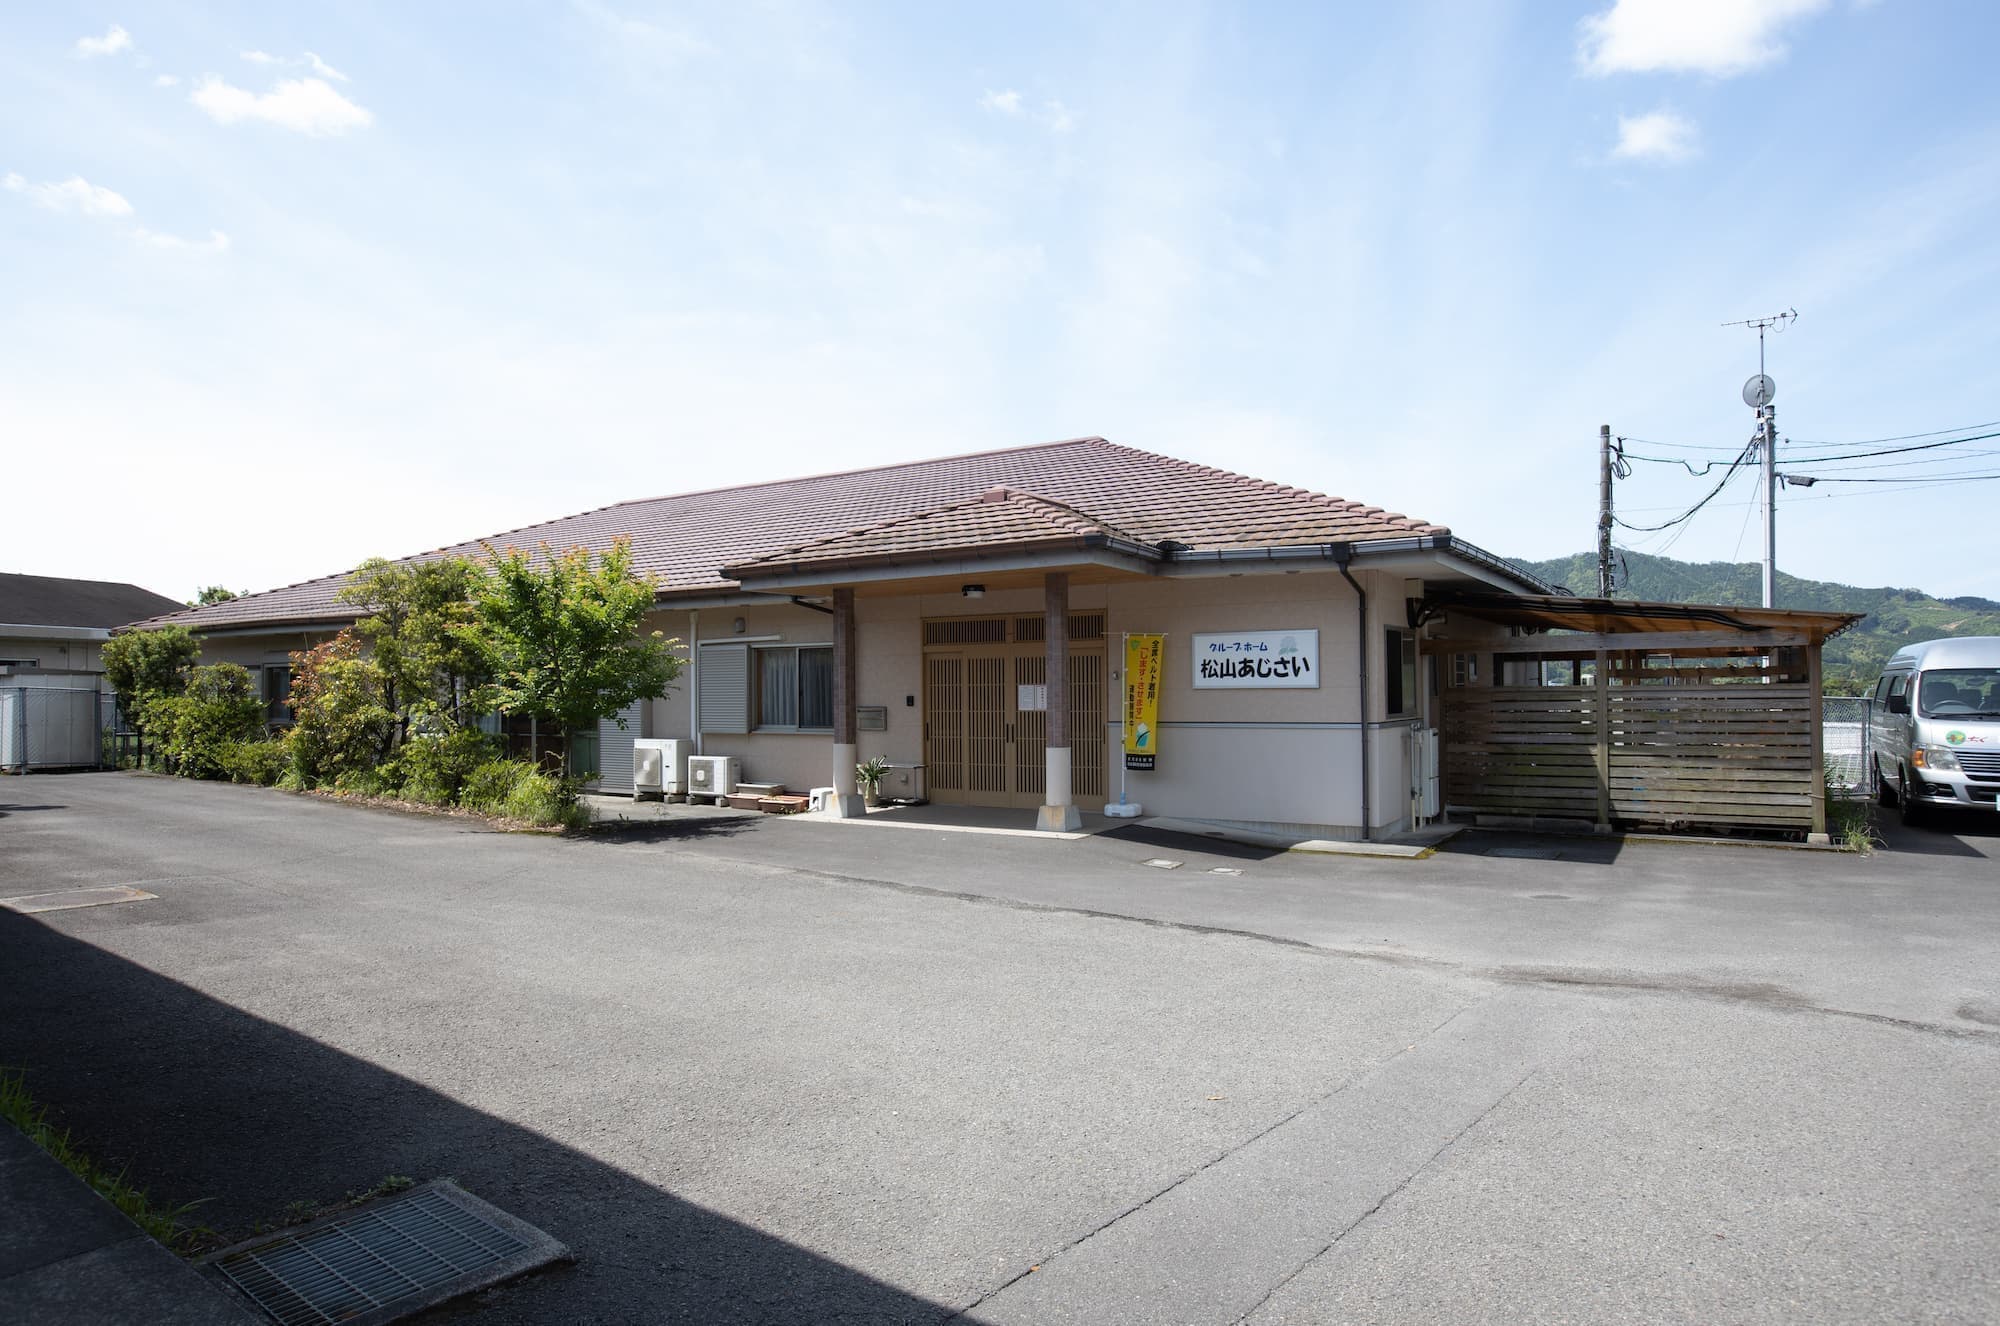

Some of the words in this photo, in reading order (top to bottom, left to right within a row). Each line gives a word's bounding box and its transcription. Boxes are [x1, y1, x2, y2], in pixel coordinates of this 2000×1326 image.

[1200, 656, 1310, 679] 松山あじさい
